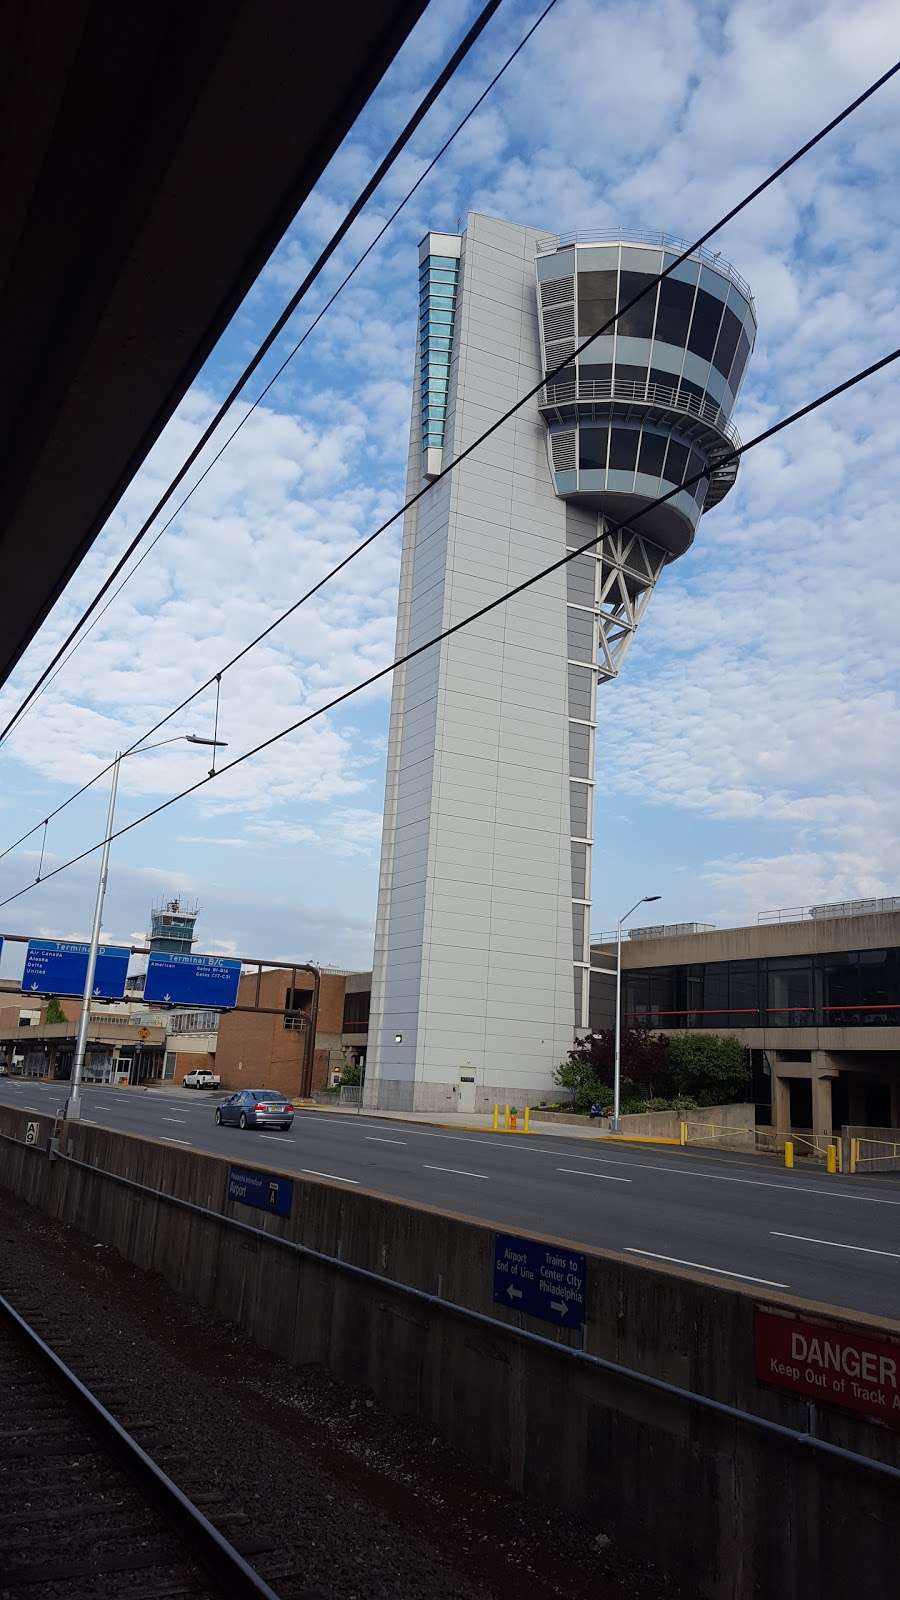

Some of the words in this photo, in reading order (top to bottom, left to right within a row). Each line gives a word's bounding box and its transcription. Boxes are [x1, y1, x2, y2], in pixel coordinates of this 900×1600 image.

[56, 944, 92, 952] Termin
[170, 955, 205, 964] Terminal
[28, 1124, 34, 1132] A
[26, 1134, 34, 1142] 9
[230, 1181, 246, 1198] Airport
[504, 1248, 527, 1264] Airport
[546, 1253, 566, 1269] Trains
[570, 1260, 578, 1271] to
[496, 1260, 508, 1272] End
[510, 1264, 518, 1274] of
[520, 1266, 534, 1280] Line
[540, 1266, 563, 1282] Center
[566, 1274, 582, 1290] City
[540, 1280, 582, 1303] Philadelphia
[791, 1332, 897, 1388] DANGER
[770, 1358, 800, 1380] Keep
[805, 1368, 827, 1388] Out
[832, 1379, 846, 1392] of
[851, 1382, 886, 1405] Track
